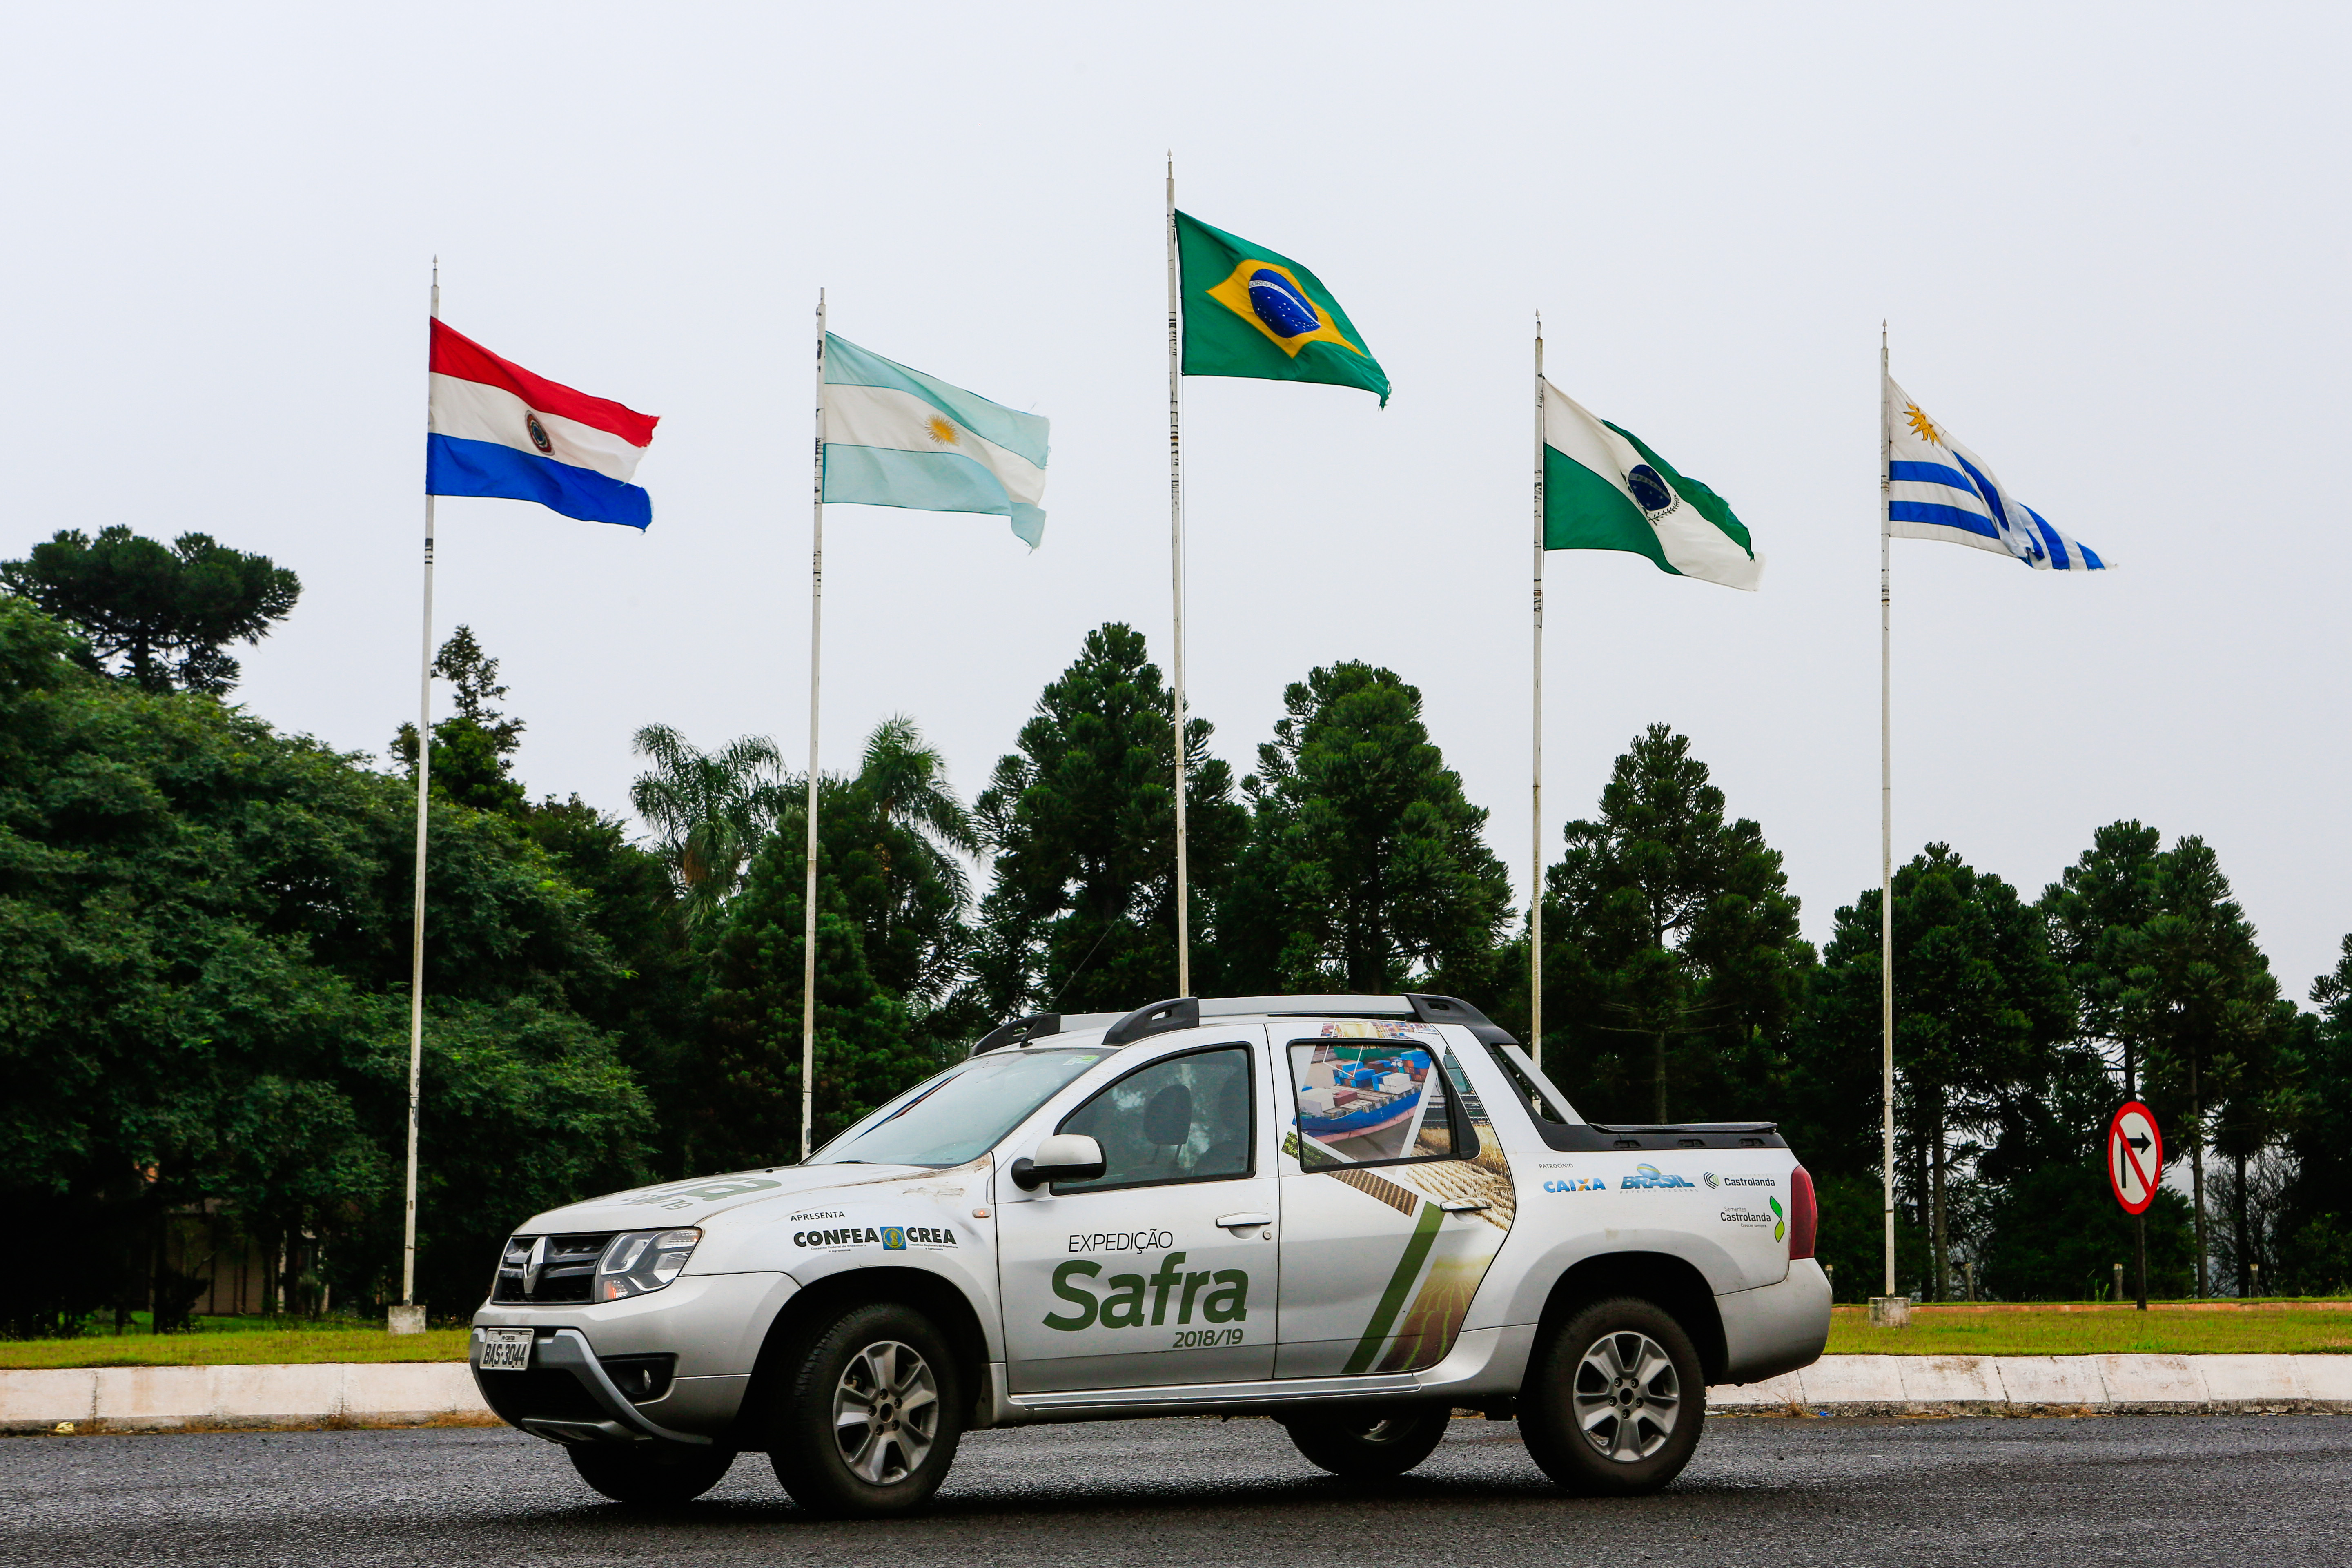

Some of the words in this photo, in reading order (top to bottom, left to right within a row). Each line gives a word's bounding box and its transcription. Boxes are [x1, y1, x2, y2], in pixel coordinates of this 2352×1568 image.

[1544, 1178, 1606, 1193] CAIXA
[1620, 1175, 1696, 1189] BRASIL
[1724, 1178, 1775, 1186] Castrolanda
[791, 1211, 845, 1221] APRESENTA
[1720, 1212, 1771, 1222] Castrolanda
[793, 1228, 880, 1247] CONFEA
[906, 1227, 957, 1245] CREA
[1068, 1228, 1173, 1254] EXPEDIÇÃO
[1042, 1252, 1249, 1331] Safra
[1172, 1328, 1243, 1348] 2018/19
